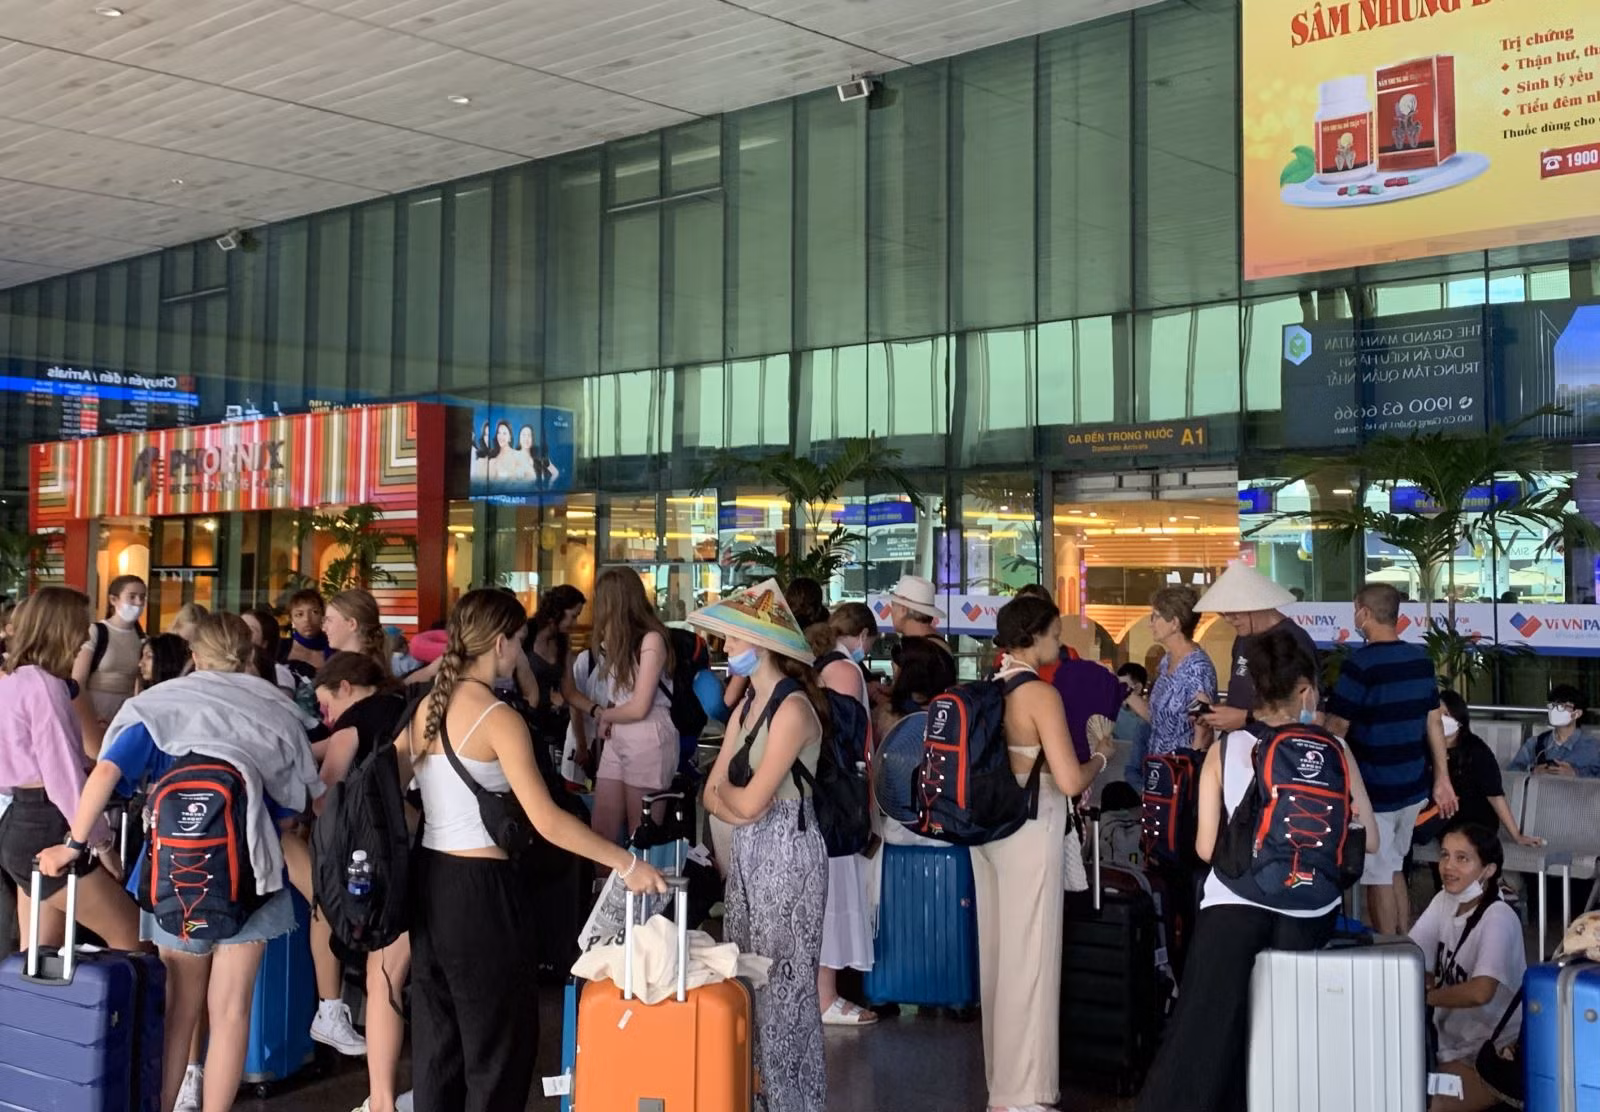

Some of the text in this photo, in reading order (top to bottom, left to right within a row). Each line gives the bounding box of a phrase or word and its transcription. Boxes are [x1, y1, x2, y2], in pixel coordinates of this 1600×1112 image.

[1290, 1, 1351, 48] SÂM
[1499, 28, 1575, 52] Trị chứng
[1515, 55, 1552, 70] Thận
[1516, 78, 1549, 93] Sinh
[1553, 73, 1565, 88] lý
[1553, 96, 1582, 109] đêm
[1501, 117, 1595, 139] Thuốc dùng cho
[1566, 149, 1599, 167] 1900
[1068, 434, 1082, 445] GA
[1084, 431, 1105, 444] ĐẾN
[1107, 430, 1142, 442] TRONG
[1180, 427, 1203, 446] A1
[1297, 615, 1337, 626] VNPAY
